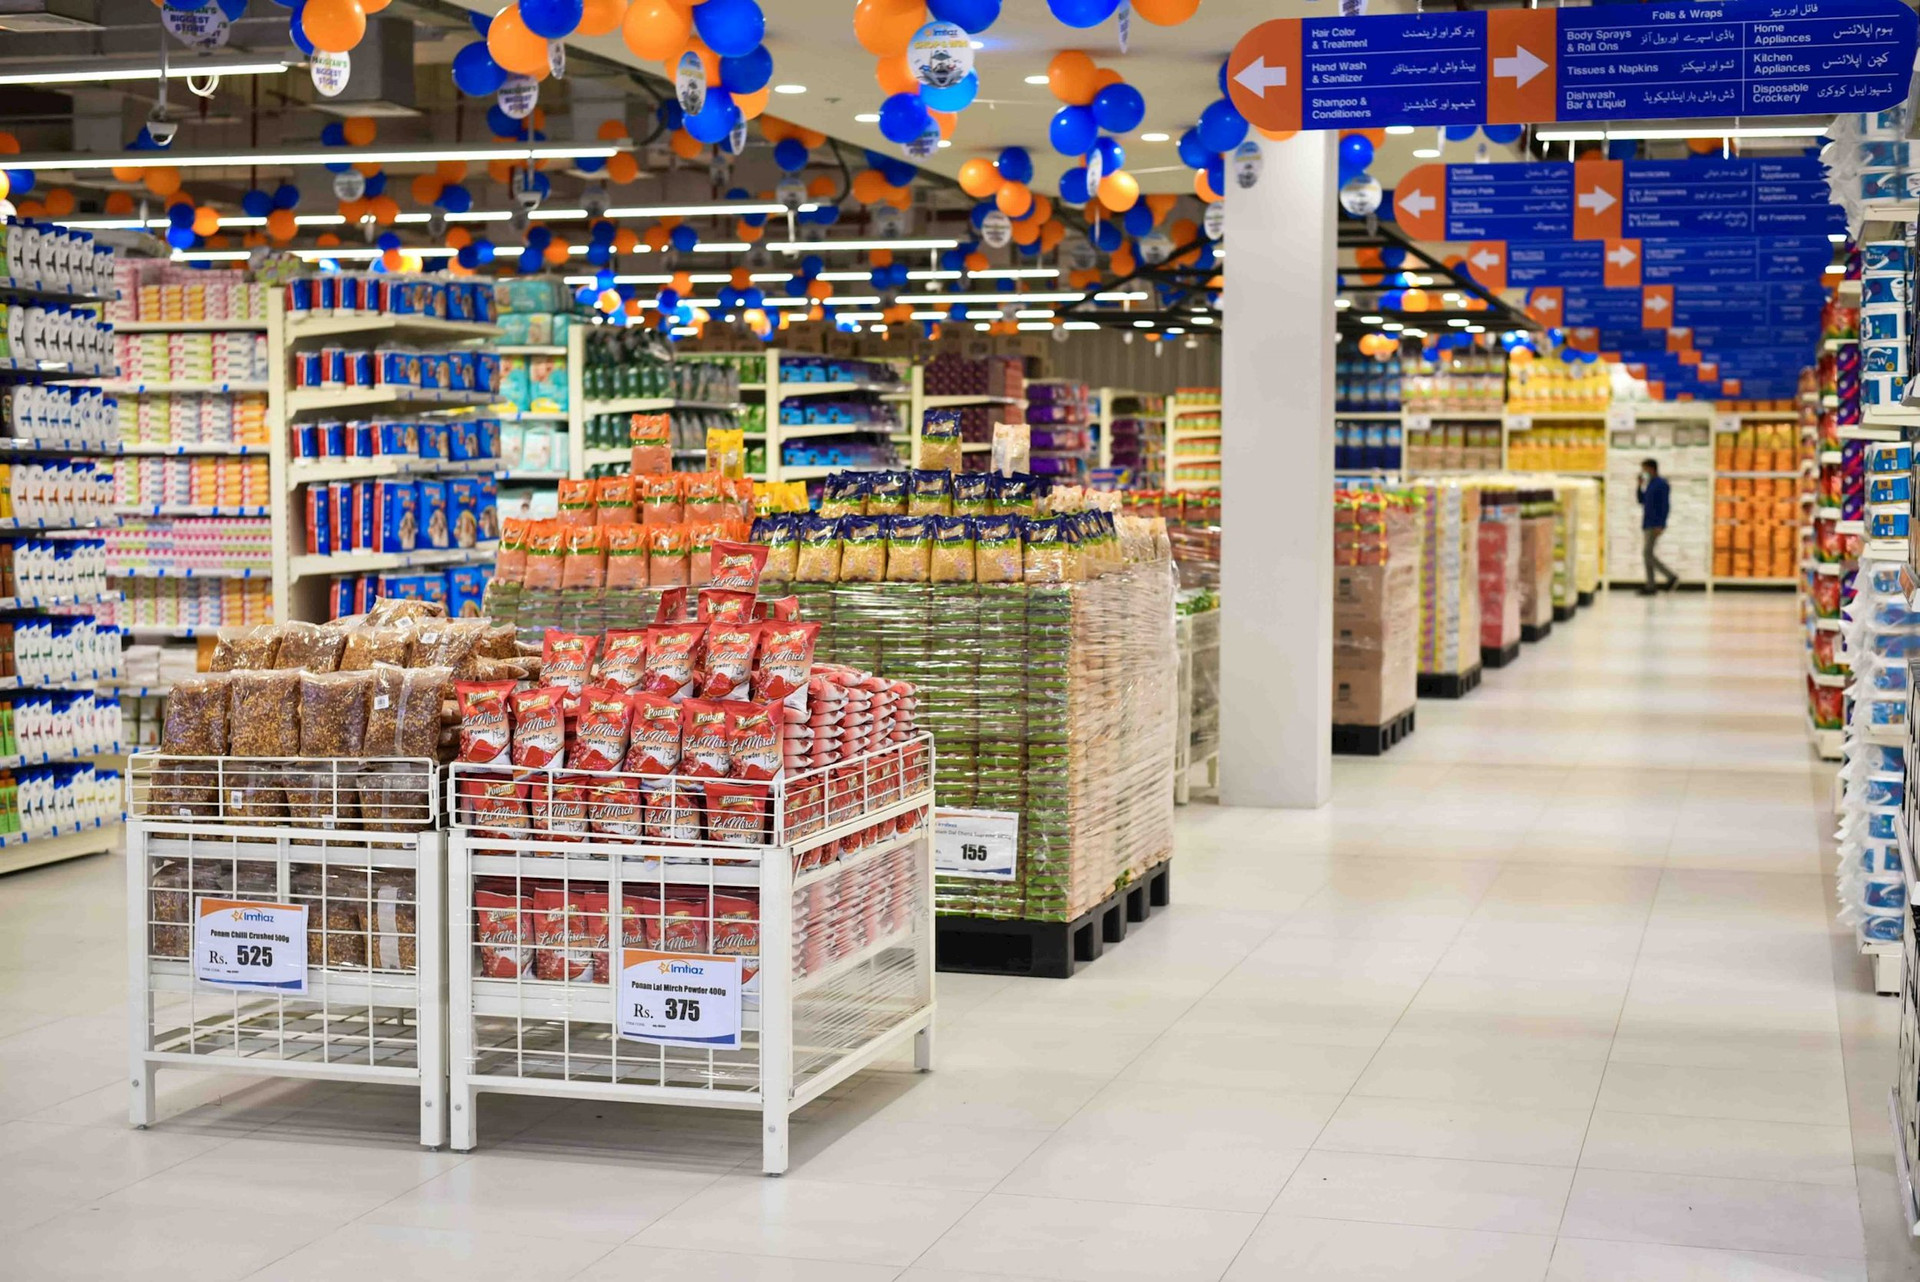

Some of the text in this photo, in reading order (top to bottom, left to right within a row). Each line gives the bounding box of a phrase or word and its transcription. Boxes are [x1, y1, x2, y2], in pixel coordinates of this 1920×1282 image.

[1652, 9, 1723, 20] Foils & Wraps
[1788, 4, 1798, 16] اور
[170, 14, 210, 23] BIGGEST
[175, 24, 205, 32] STORE
[1312, 28, 1356, 38] Hair Color
[1438, 27, 1448, 38] اور
[1754, 24, 1784, 32] Home
[1566, 30, 1632, 42] Body Sprays
[1668, 32, 1678, 44] اور
[1754, 34, 1812, 46] Appliances
[1312, 39, 1368, 50] & Treatment
[1567, 42, 1619, 52] & Roll Ons
[1753, 53, 1793, 62] Kitchen
[1312, 62, 1367, 72] Hand Wash
[1428, 62, 1438, 74] اور
[1567, 64, 1658, 75] Tissues & Napkins
[1707, 60, 1718, 72] اور
[1754, 64, 1810, 76] Appliances
[1312, 74, 1363, 84] & Sanitizer
[1752, 83, 1809, 94] Disposable
[1566, 90, 1616, 100] Dishwash
[1752, 93, 1800, 104] Crockery
[1312, 96, 1367, 108] Shampoo &
[1439, 99, 1450, 110] اور
[1566, 99, 1626, 110] Bar & Liquid
[1312, 109, 1372, 119] Conditioners
[725, 573, 754, 587] Mirch
[613, 654, 639, 666] Mirch
[660, 651, 690, 662] Mirch
[718, 650, 749, 662] Mirch
[760, 650, 806, 667] Lal Mirch
[554, 660, 586, 672] Mirch
[475, 712, 504, 724] Mirch
[526, 718, 556, 732] Mirch
[579, 724, 624, 738] Lal Mirch
[522, 734, 540, 744] Powder
[633, 729, 680, 744] Lal Mirch
[684, 736, 728, 750] Lal Mirc
[730, 736, 776, 756] Lal Mirch
[535, 806, 548, 819] La
[590, 804, 634, 819] Lal Mirch
[648, 811, 662, 824] Lal
[712, 816, 759, 831] Lal Mirch
[961, 844, 987, 861] 155
[244, 912, 274, 922] Imtiaz
[210, 929, 290, 943] Ponam Chilli Crushed 500g
[482, 932, 496, 944] Lal
[540, 932, 554, 946] Lal
[726, 934, 756, 947] Mirch
[668, 936, 698, 950] Mirch
[209, 945, 273, 967] Rs. 525
[671, 964, 704, 975] Imtiaz
[632, 981, 726, 996] Ponam Lal Mirch Powder 400g
[634, 998, 700, 1022] Rs. 375
